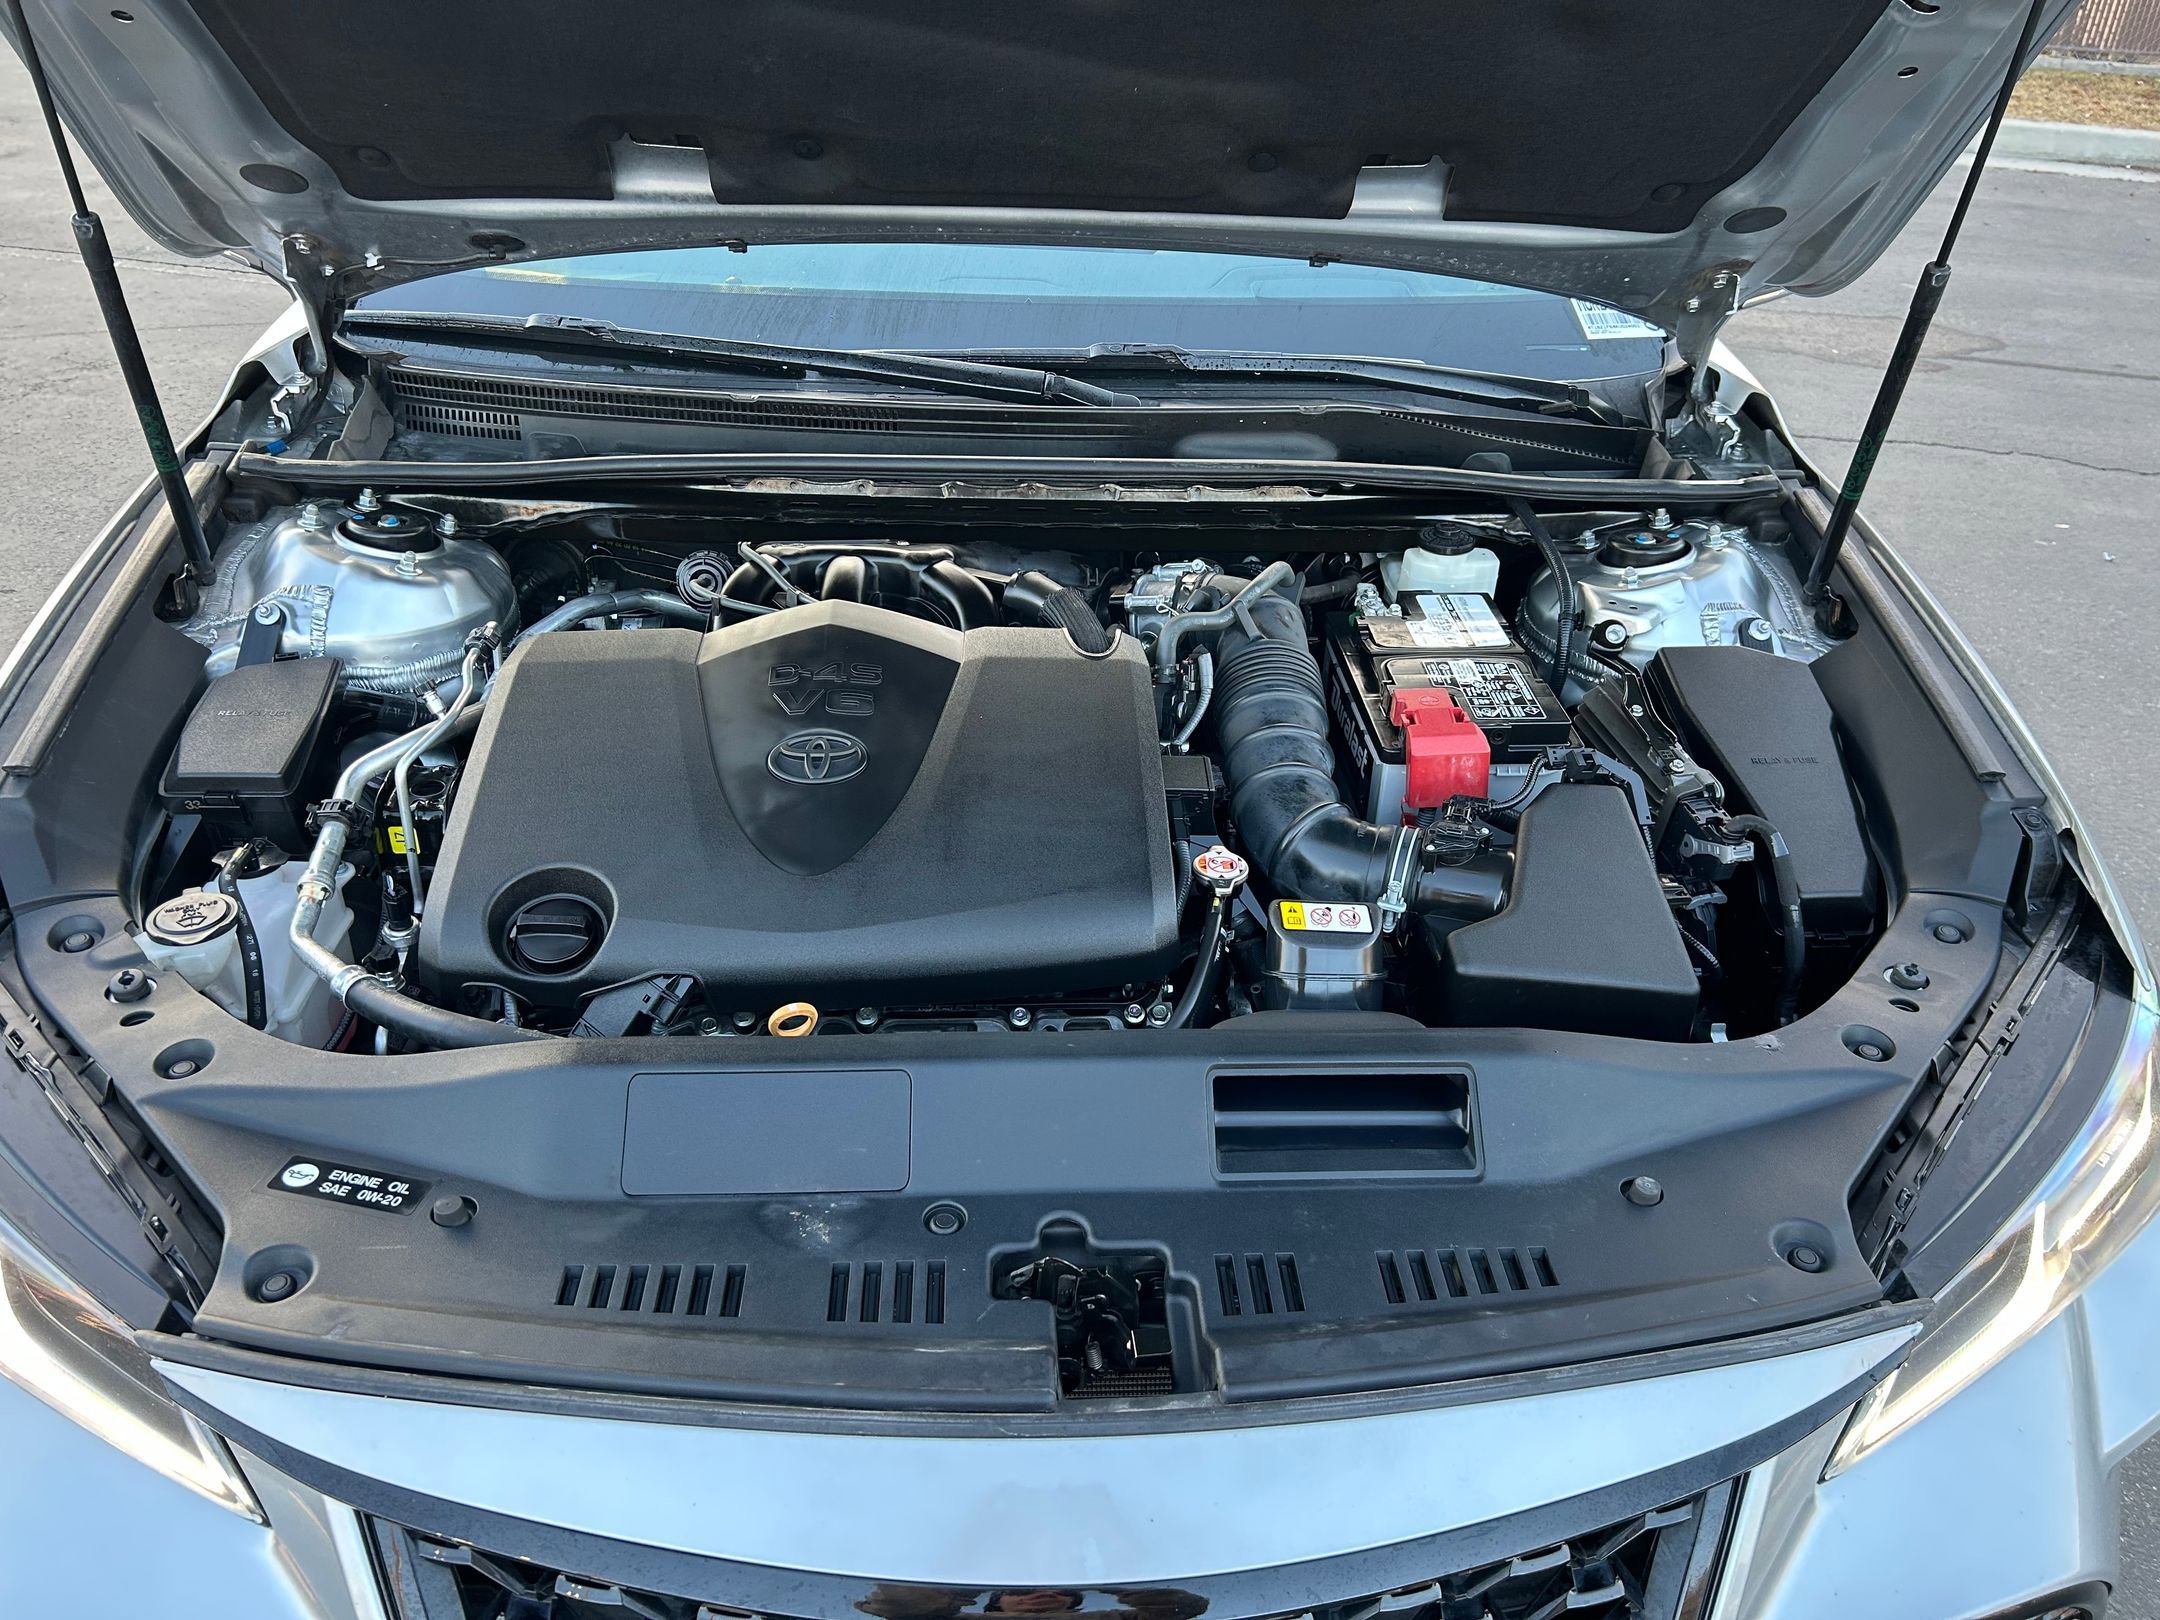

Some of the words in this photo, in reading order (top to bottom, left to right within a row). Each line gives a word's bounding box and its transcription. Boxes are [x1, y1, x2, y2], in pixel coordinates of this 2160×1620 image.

[767, 661, 884, 687] D-4S
[772, 688, 875, 716] V6
[1330, 674, 1368, 780] Duralast
[318, 1181, 353, 1197] SAE
[356, 1189, 404, 1207] 0W-20
[328, 1169, 384, 1189] ENGINE
[387, 1180, 411, 1195] OIL
